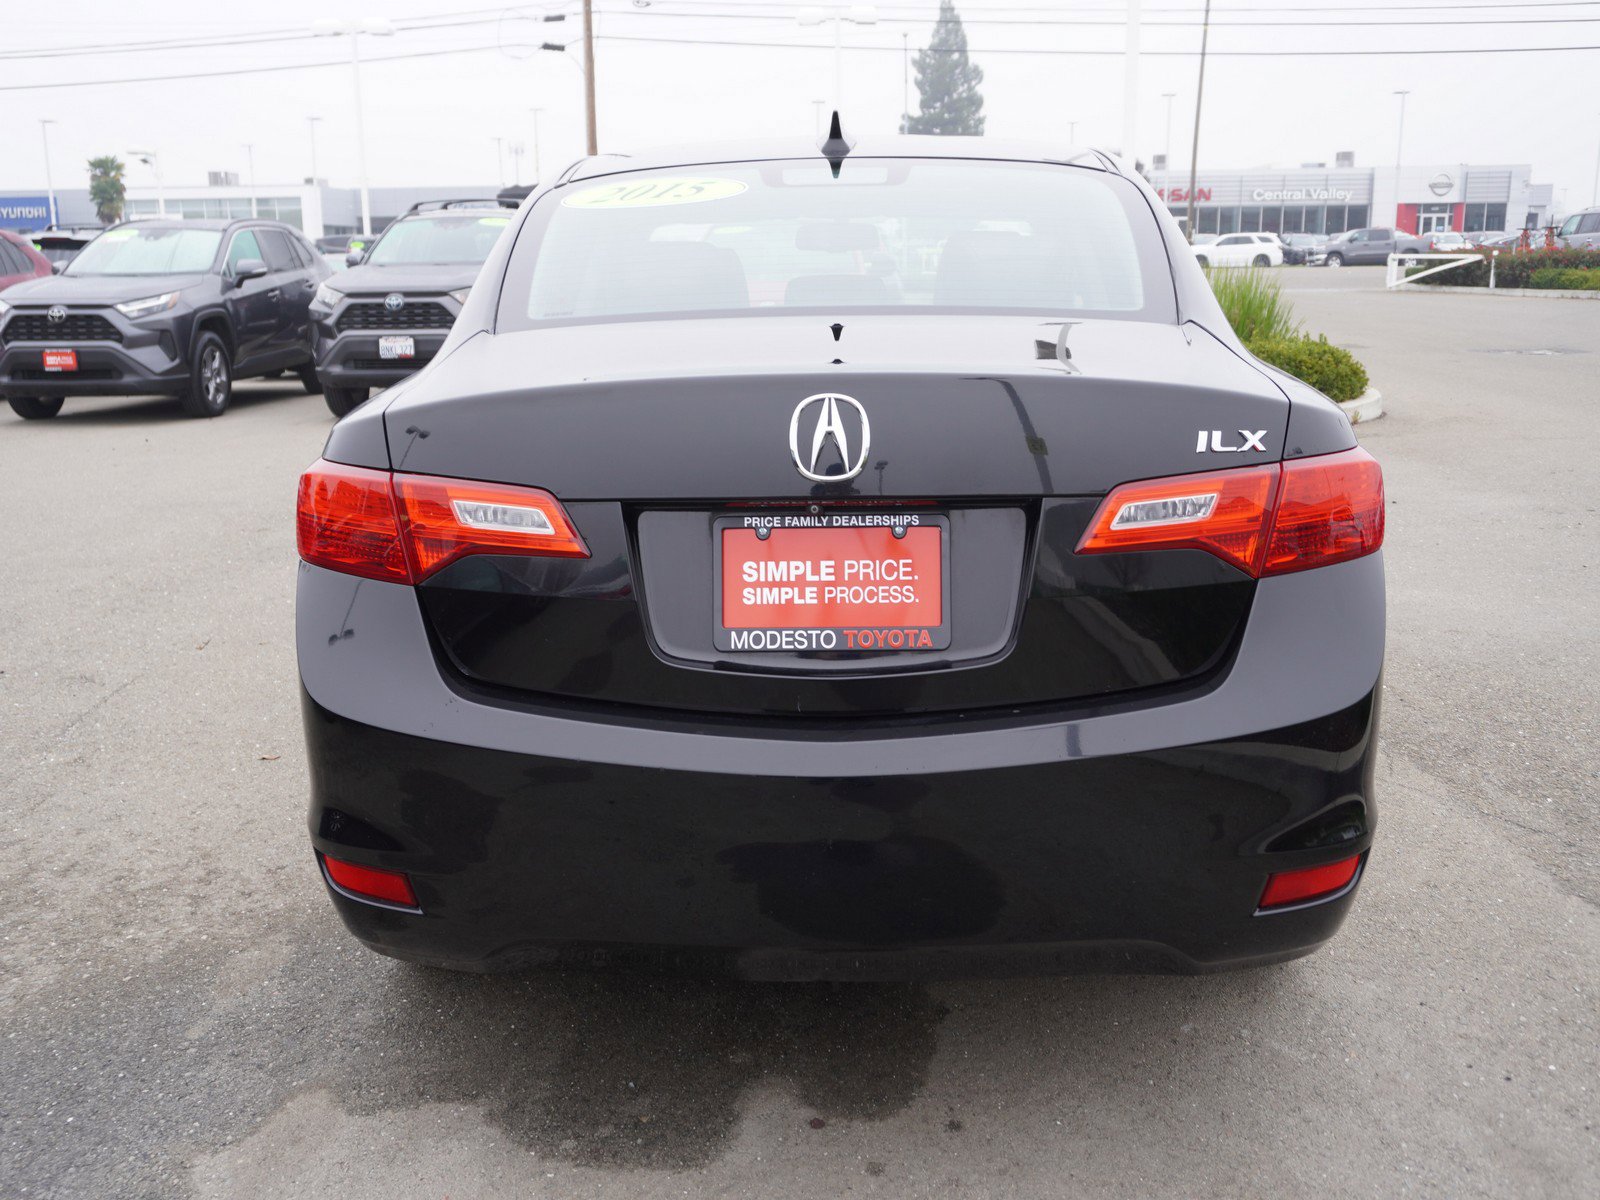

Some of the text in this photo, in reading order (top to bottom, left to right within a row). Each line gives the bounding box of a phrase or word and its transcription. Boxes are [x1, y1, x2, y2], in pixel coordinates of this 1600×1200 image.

[588, 181, 718, 204] 2015
[1252, 187, 1353, 203] Central Valley
[0, 206, 47, 219] YUNDAI
[1195, 429, 1268, 453] ILX
[743, 514, 920, 528] PRICE FAMILY DEALERSHIPS
[742, 559, 919, 582] SIMPLE PRICE.
[742, 585, 919, 605] SIMPLE PROCESS.
[730, 629, 934, 650] MODESTO TOYOTA
